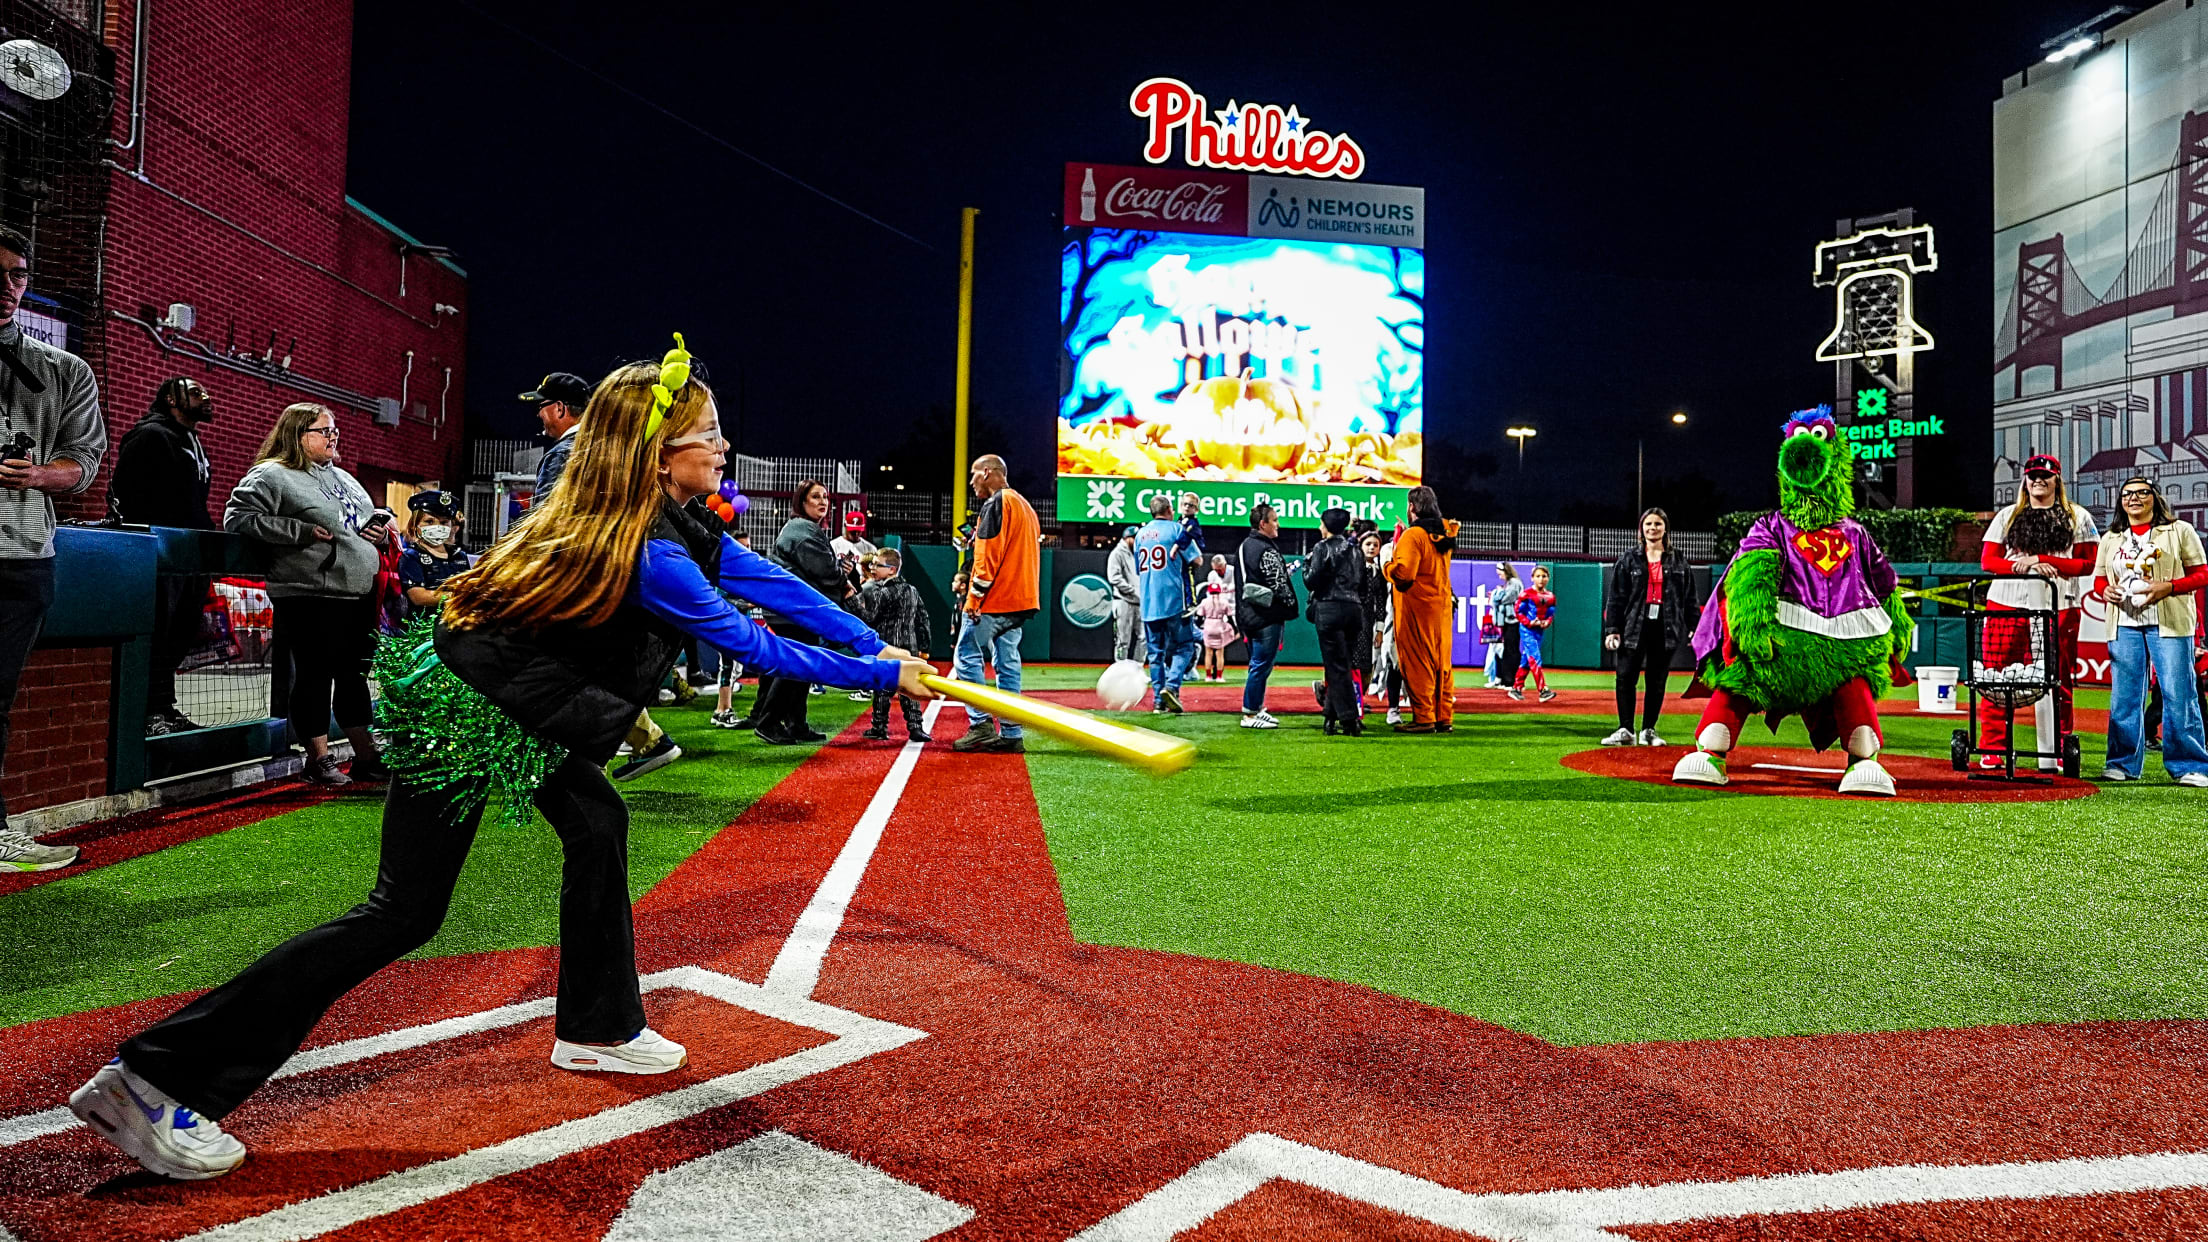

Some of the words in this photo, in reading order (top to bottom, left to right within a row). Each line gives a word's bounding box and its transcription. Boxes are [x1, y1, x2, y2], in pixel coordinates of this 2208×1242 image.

[1131, 78, 1364, 179] Phillies
[1104, 177, 1231, 222] Coca-Cola
[1307, 198, 1414, 220] NEMOURS
[1307, 218, 1371, 234] CHILDREN'S
[1374, 223, 1414, 237] HEALTH
[1888, 415, 1944, 437] Bank
[1849, 438, 1896, 460] Park
[1138, 545, 1168, 573] 29
